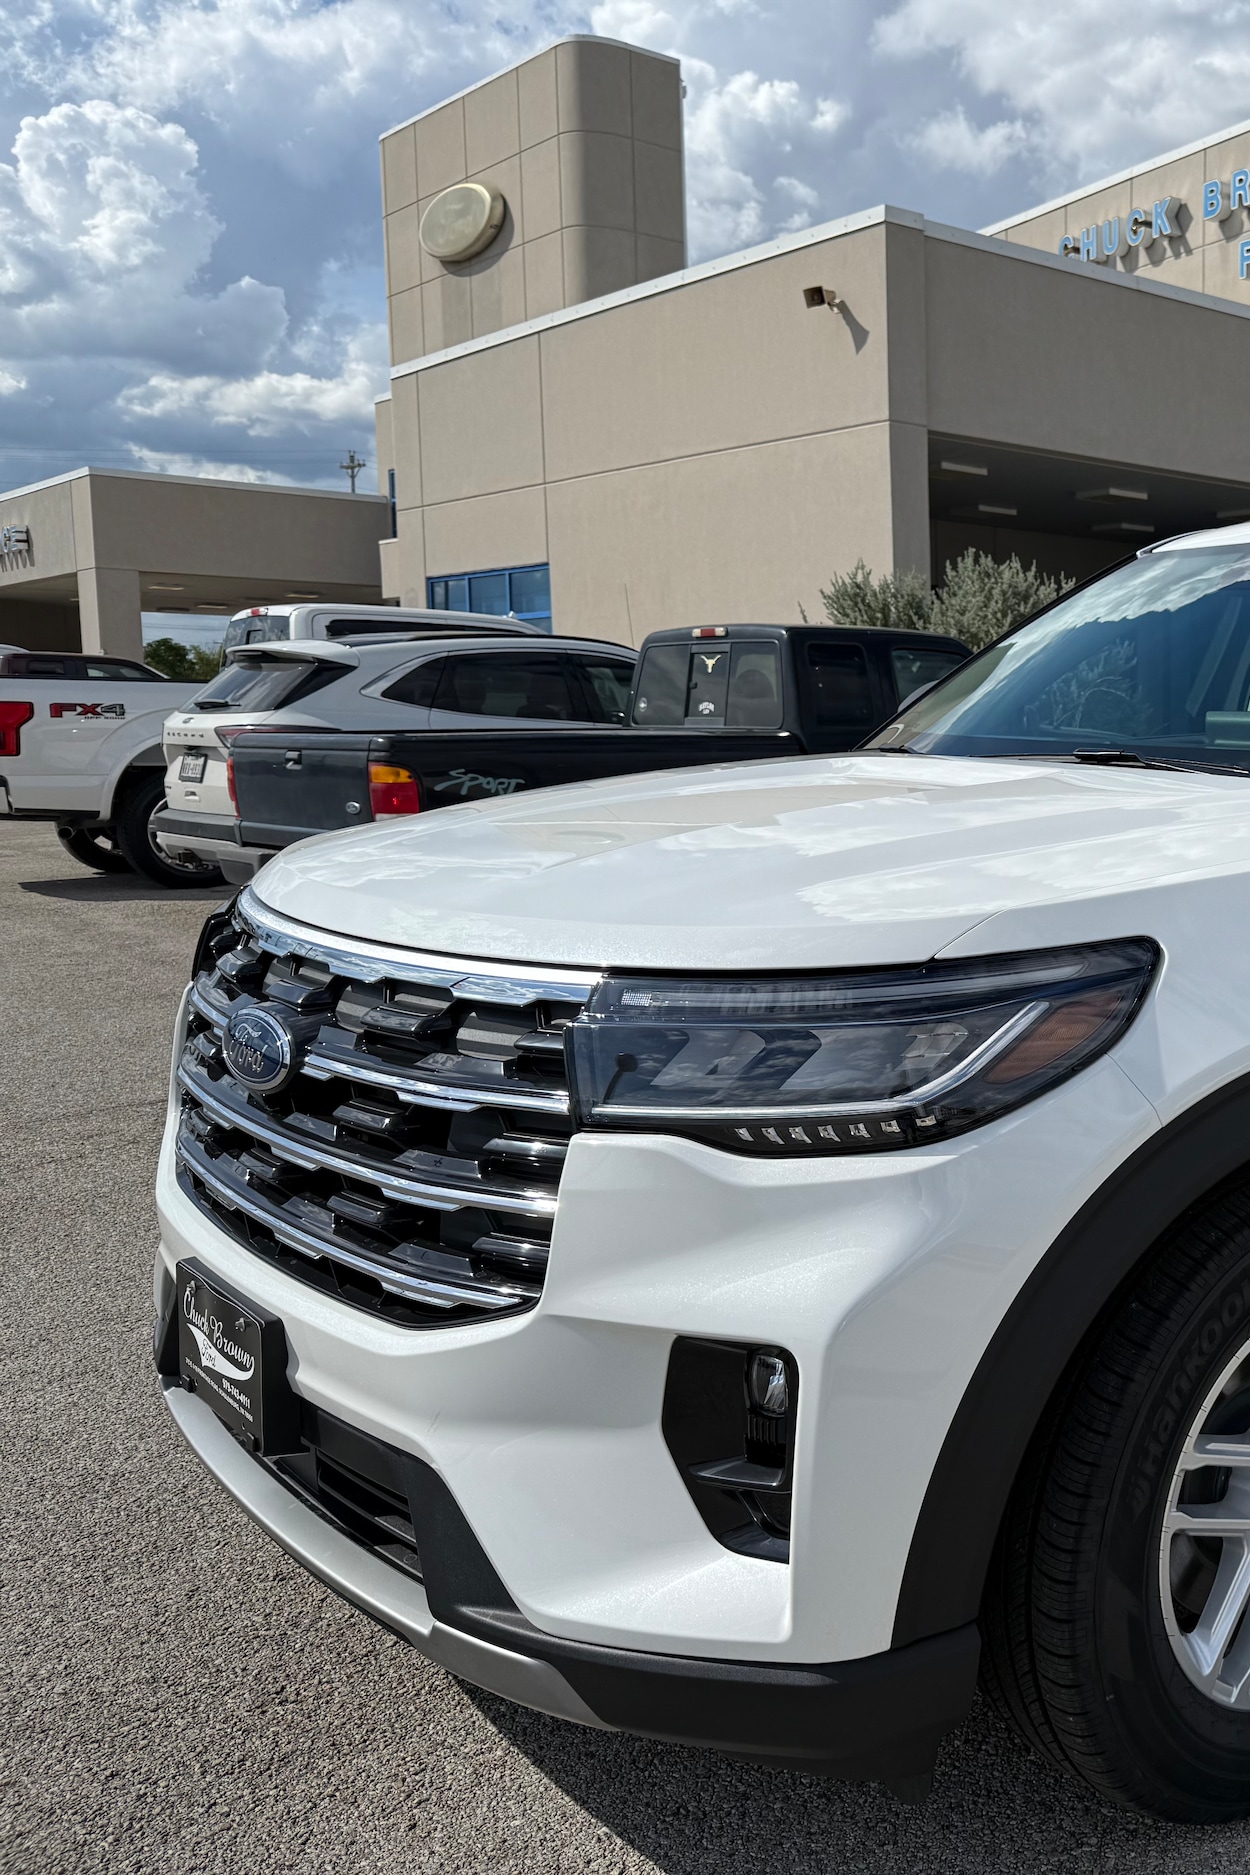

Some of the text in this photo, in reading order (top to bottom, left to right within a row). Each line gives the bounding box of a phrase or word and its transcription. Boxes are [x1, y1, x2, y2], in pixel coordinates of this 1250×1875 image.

[1058, 196, 1180, 263] CHUCK
[49, 702, 126, 718] FX4
[183, 1287, 255, 1369] Chuck Brown
